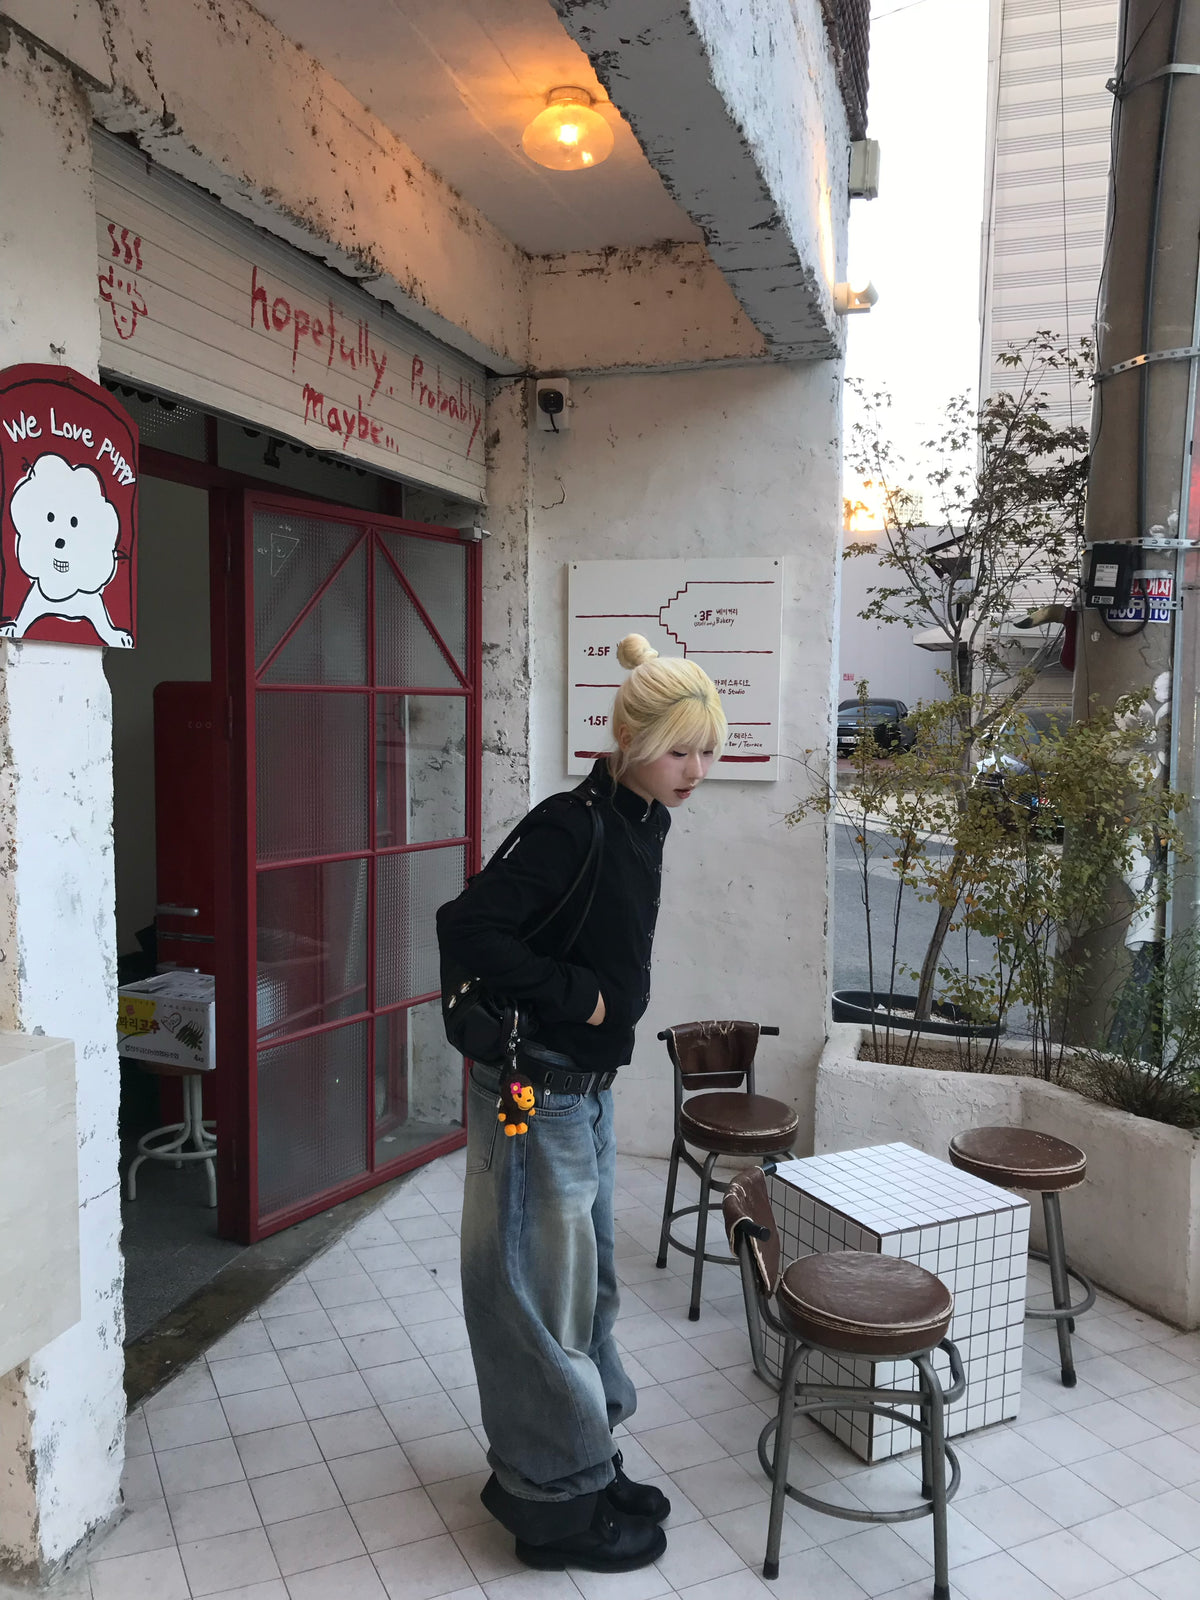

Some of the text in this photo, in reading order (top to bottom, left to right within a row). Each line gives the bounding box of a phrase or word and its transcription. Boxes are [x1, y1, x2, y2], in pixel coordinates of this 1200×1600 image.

[411, 353, 482, 458] Probably
[2, 409, 42, 443] We
[50, 407, 95, 448] Love
[699, 609, 713, 621] 3F
[715, 616, 735, 627] Bakery
[587, 647, 610, 656] 2.5F
[588, 716, 608, 726] 1.5F
